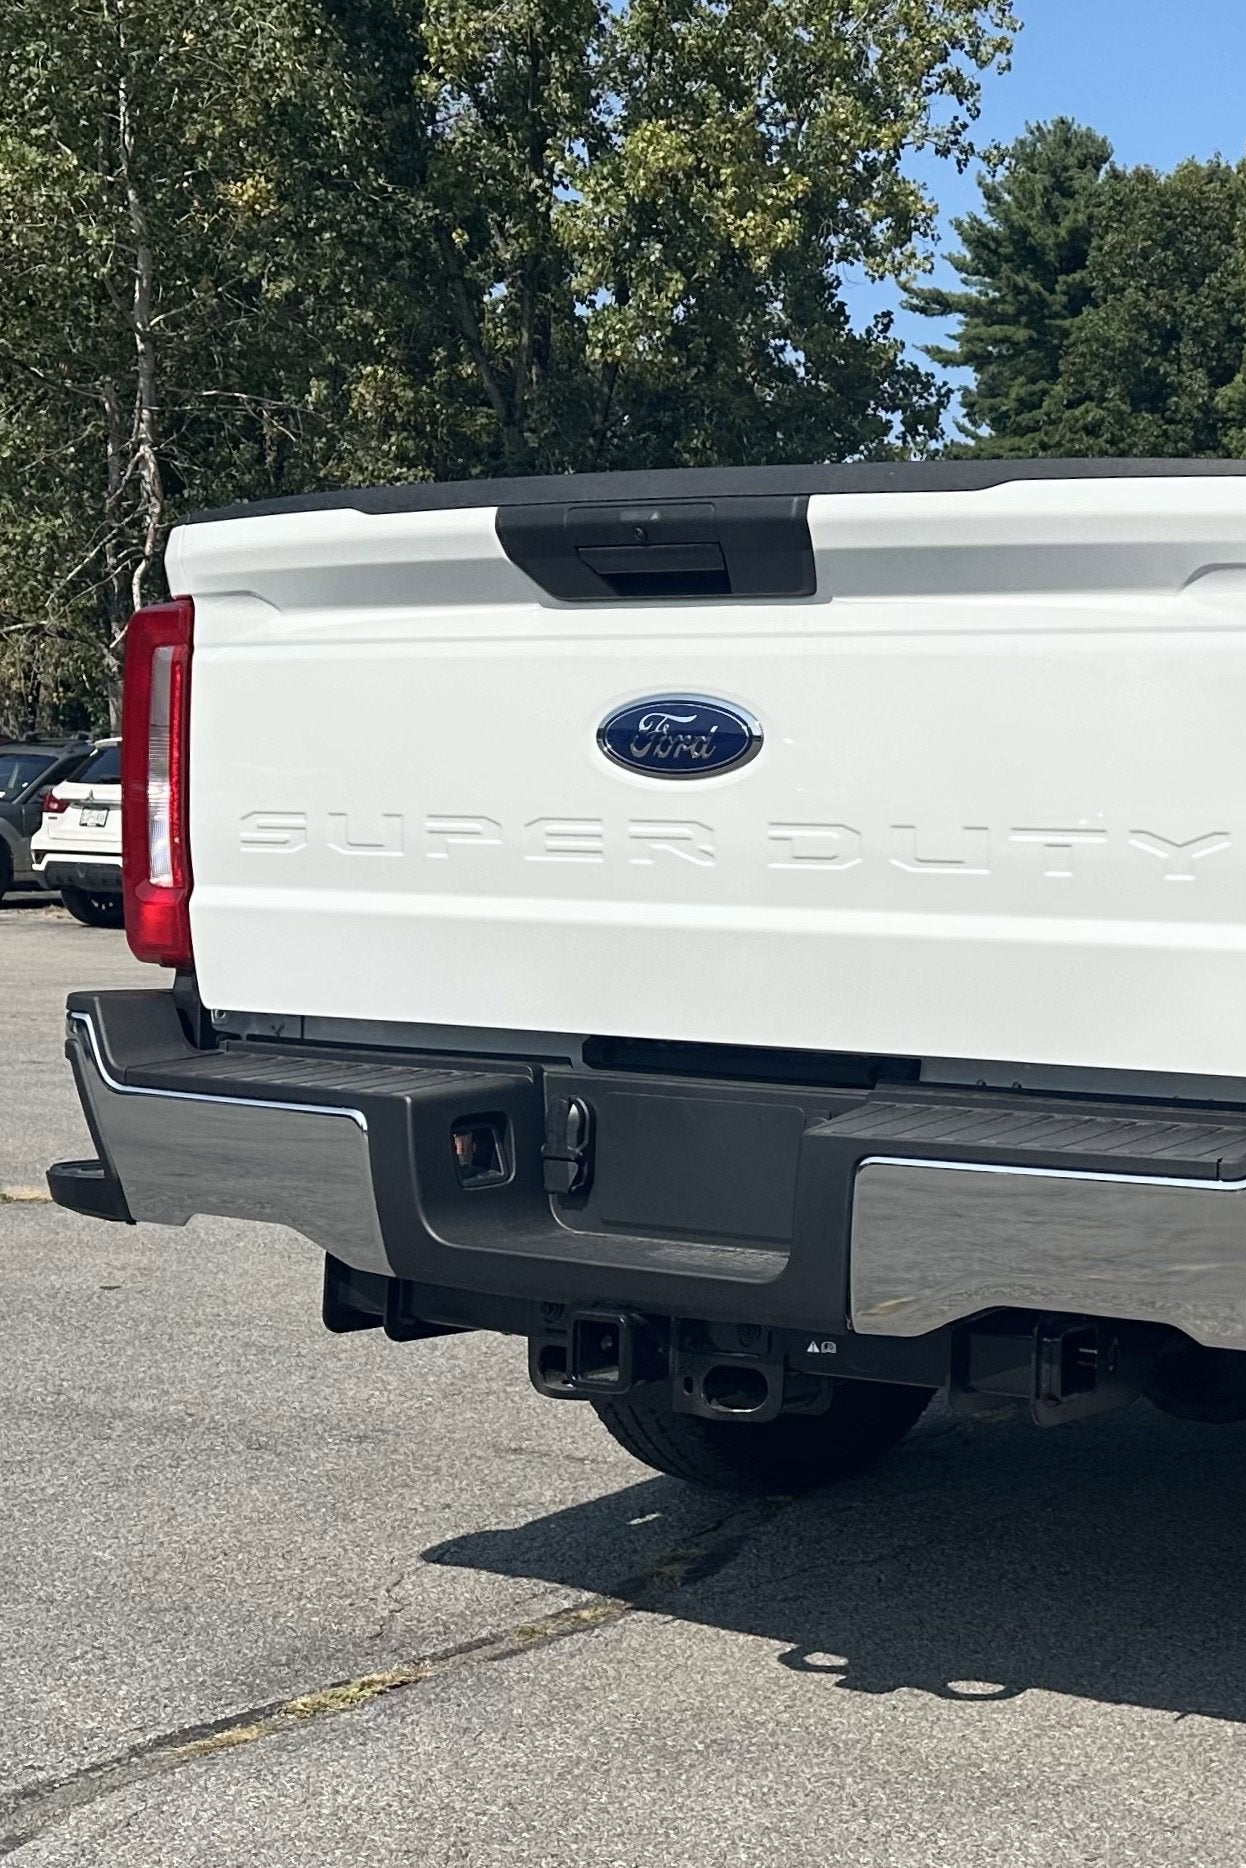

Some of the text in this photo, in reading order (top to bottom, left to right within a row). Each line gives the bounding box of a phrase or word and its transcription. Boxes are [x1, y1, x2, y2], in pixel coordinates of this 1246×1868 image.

[630, 711, 719, 759] Ford
[240, 811, 1232, 881] SUPER DUTY
